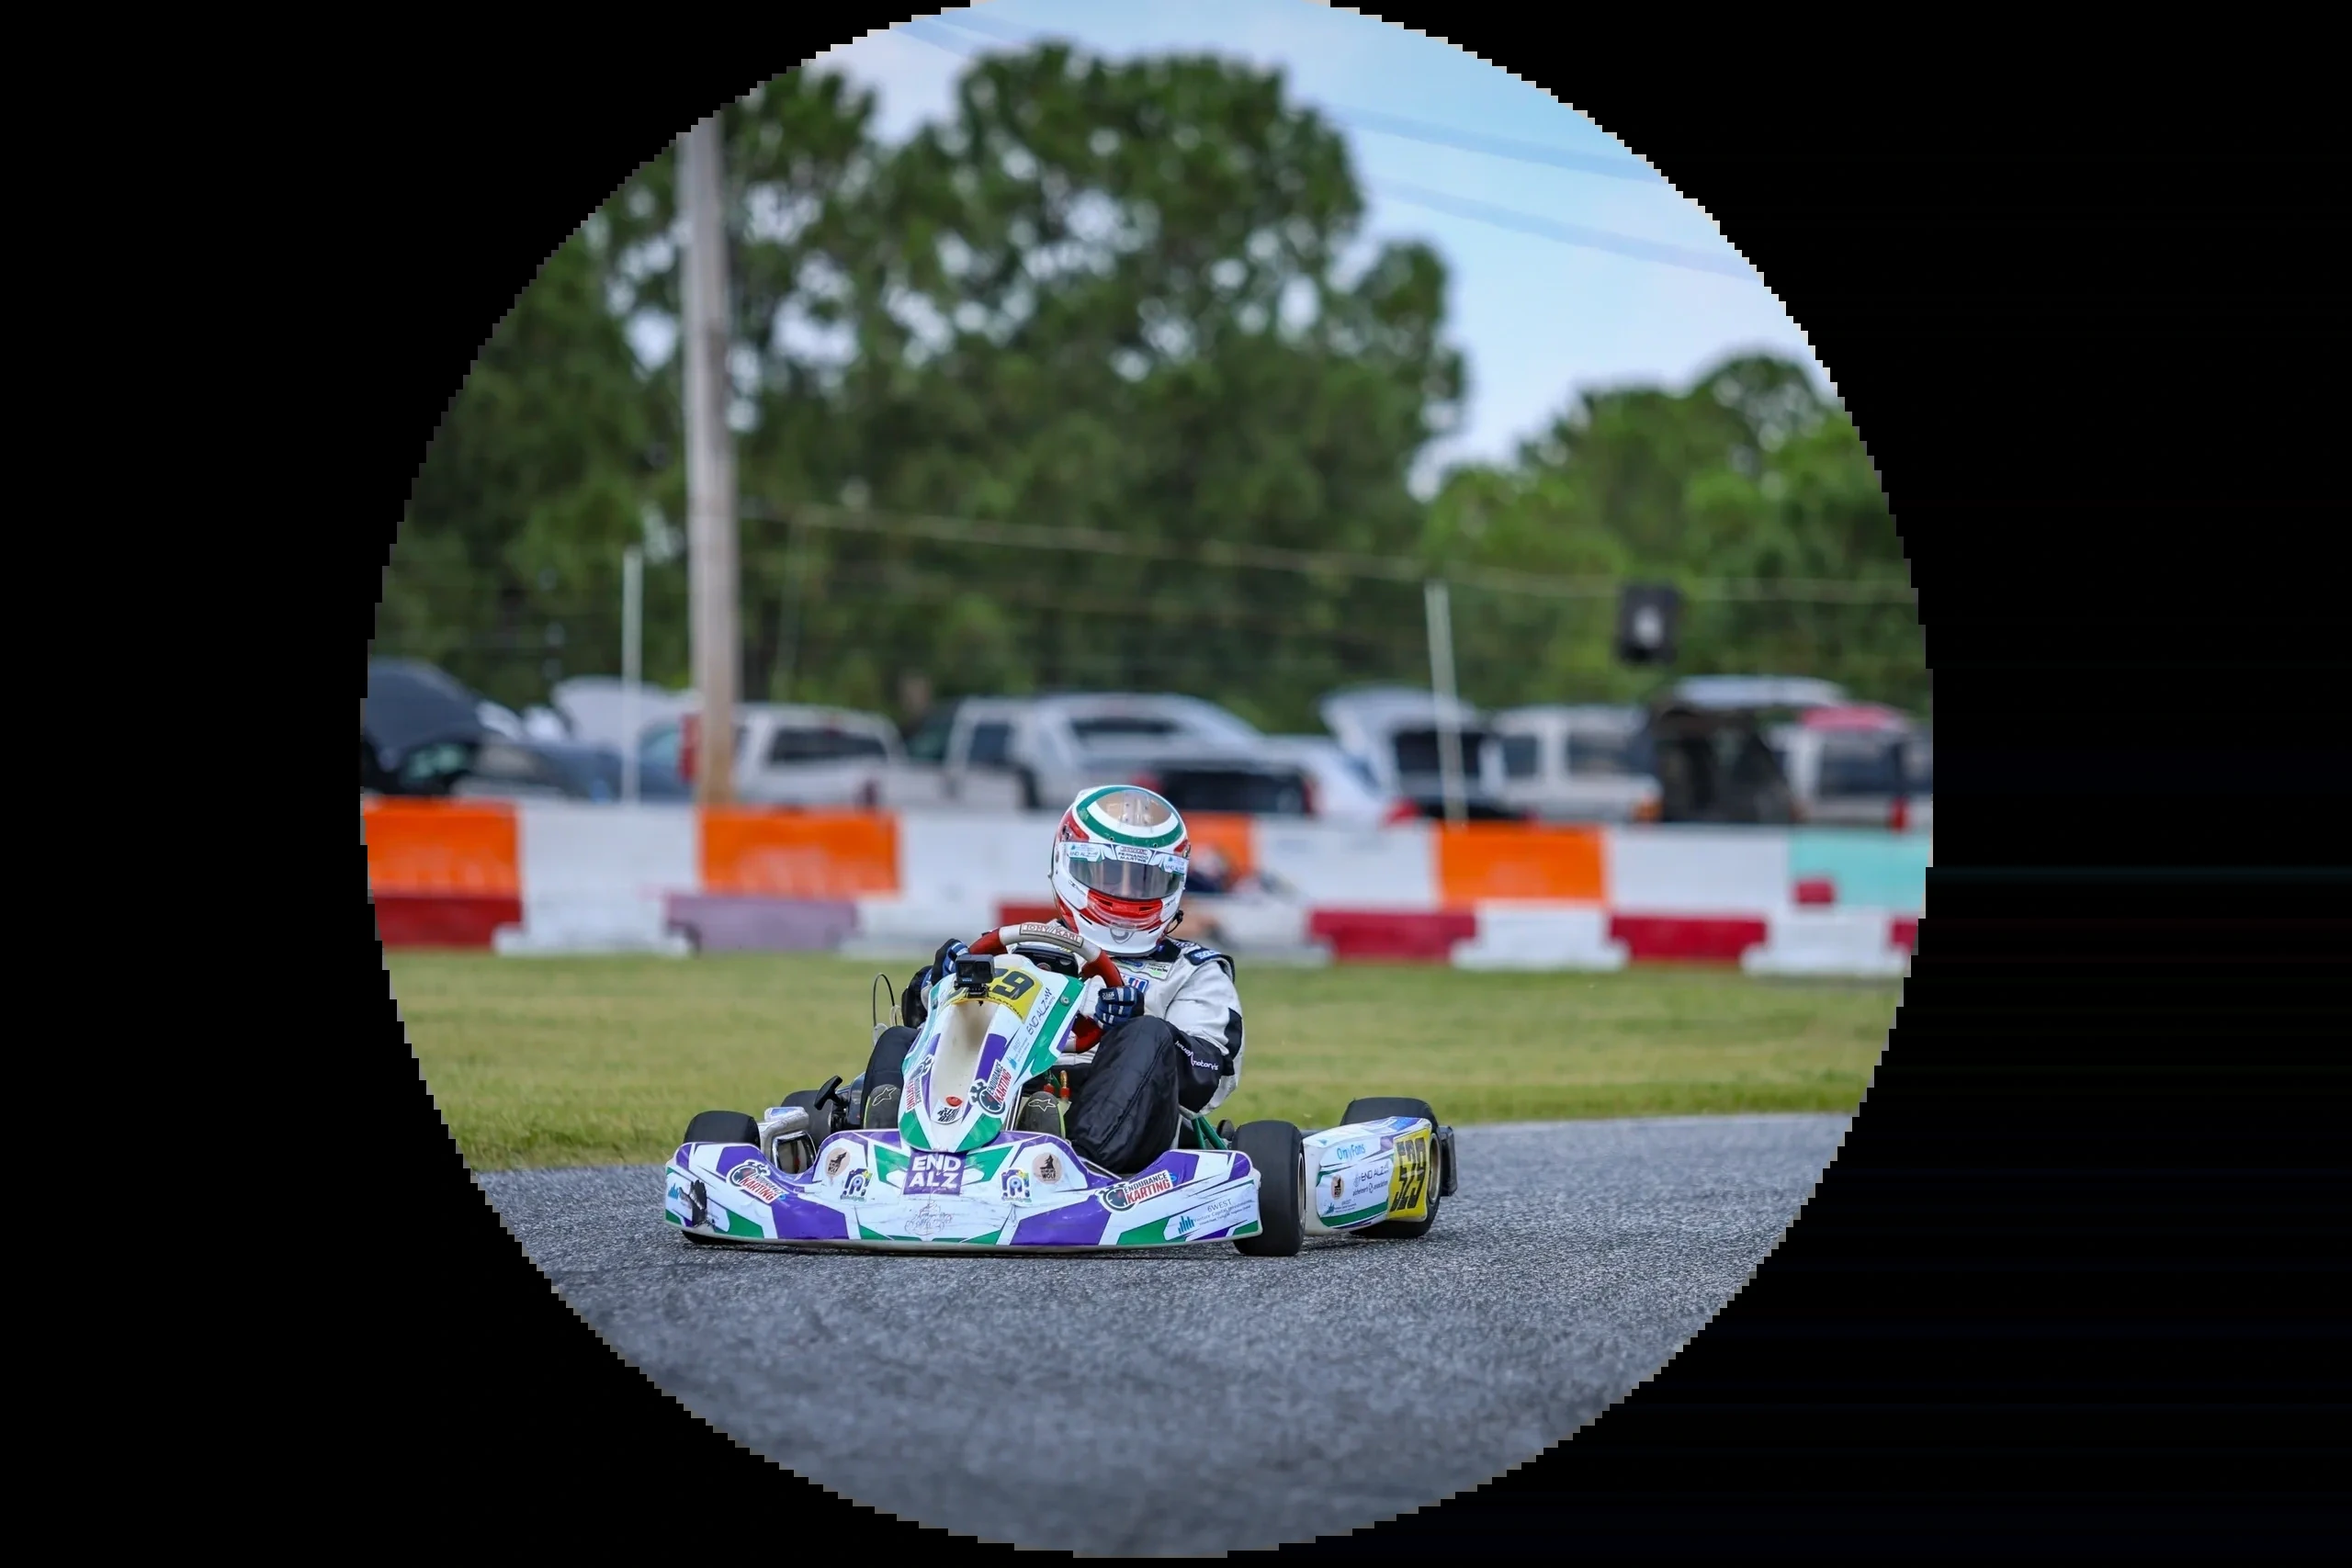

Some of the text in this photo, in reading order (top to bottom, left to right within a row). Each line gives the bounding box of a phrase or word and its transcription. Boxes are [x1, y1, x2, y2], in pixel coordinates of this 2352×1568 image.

[994, 1068, 1012, 1102] KARTING
[911, 1154, 961, 1171] END
[1337, 1144, 1365, 1161] OnlyFans
[739, 1177, 777, 1201] KARTING
[909, 1170, 959, 1189] ALZ
[1124, 1172, 1168, 1194] ENDURANCE
[1126, 1179, 1170, 1204] KARTING
[1207, 1199, 1232, 1213] 6WEST
